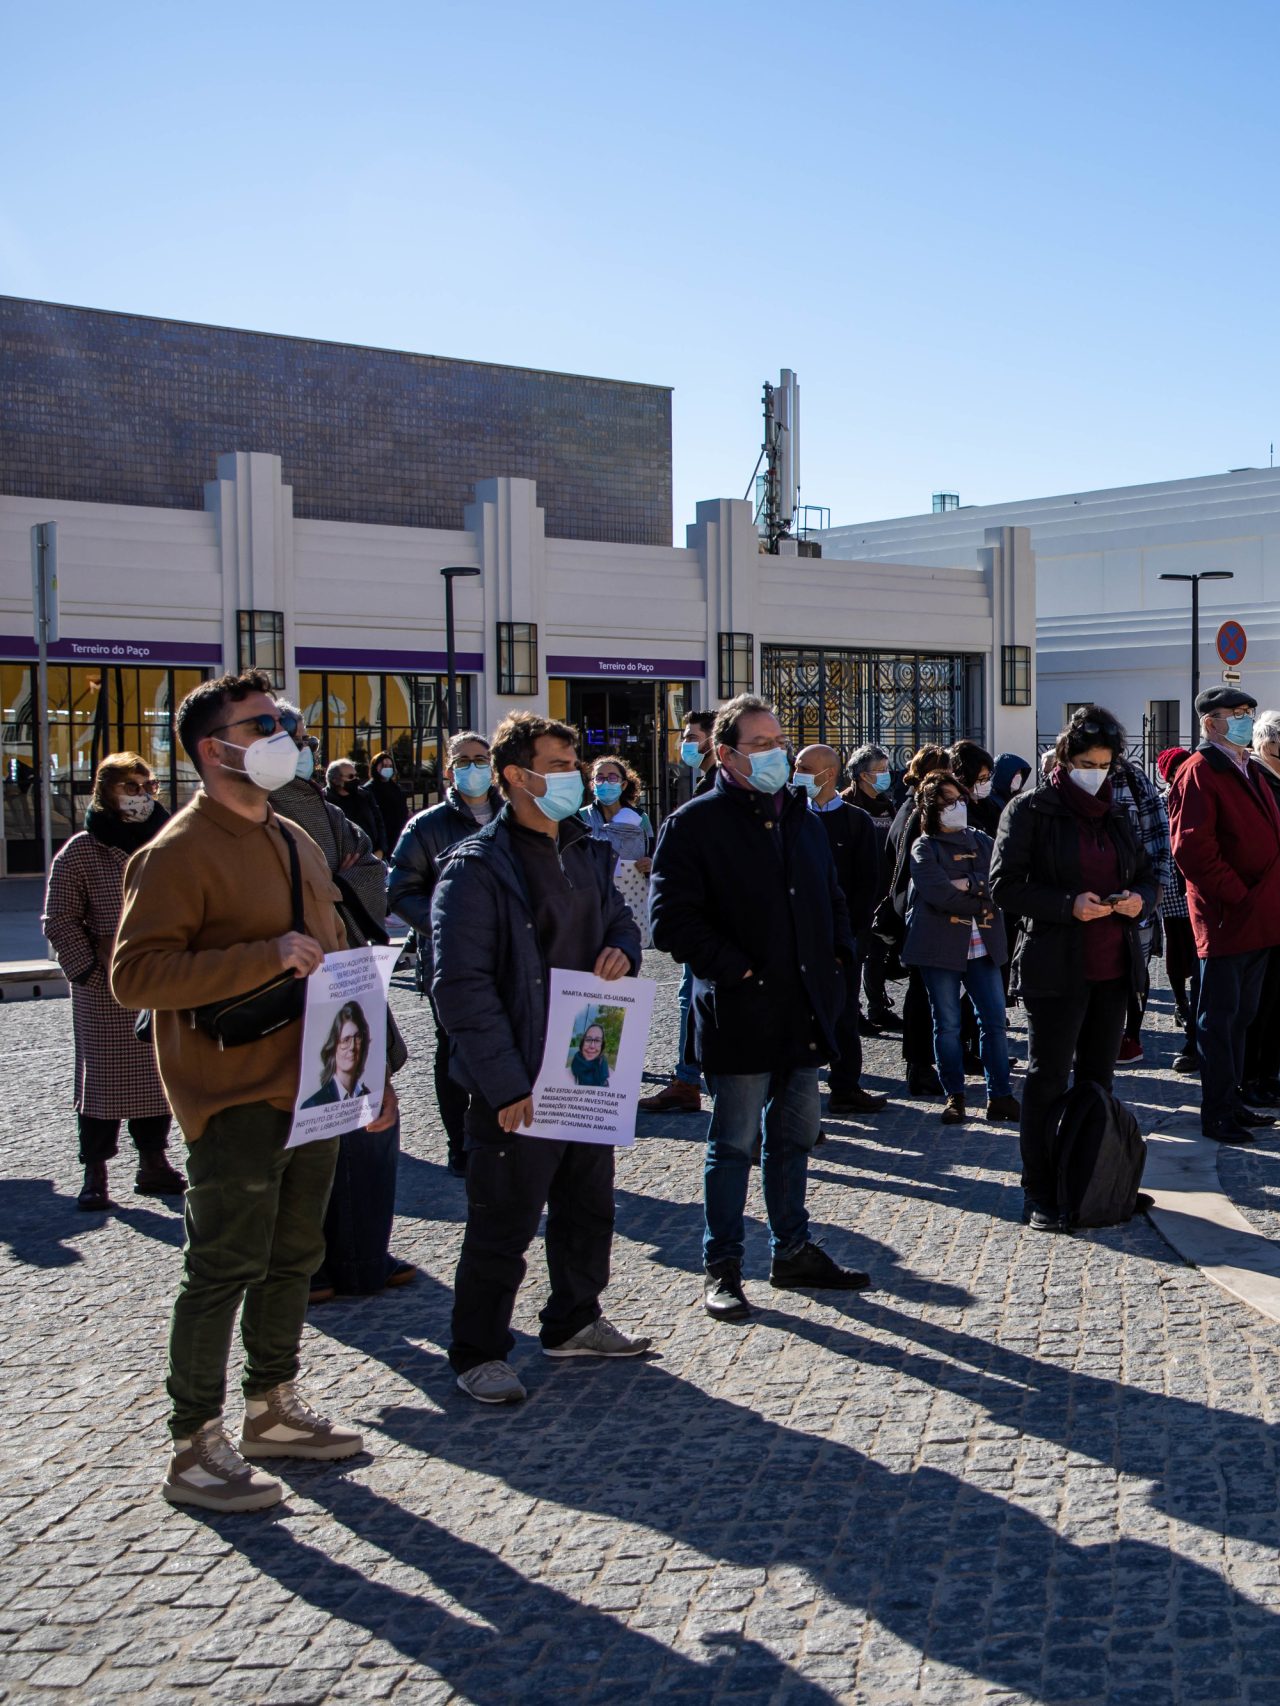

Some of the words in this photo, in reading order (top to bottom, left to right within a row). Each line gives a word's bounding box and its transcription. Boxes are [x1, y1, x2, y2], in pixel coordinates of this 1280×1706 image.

[71, 643, 110, 654] Terreiro
[112, 645, 125, 655] do
[126, 646, 150, 658] Paço
[598, 661, 626, 670] Terreiro
[627, 662, 636, 671] do
[637, 663, 654, 673] Paço
[363, 965, 369, 973] DE
[597, 1090, 615, 1098] ESTAR
[584, 1097, 619, 1107] INVESTIGAR
[324, 1104, 340, 1114] ALICE
[548, 1111, 594, 1121] FINANCIAMENTO
[295, 1117, 326, 1128] INSTITUTO
